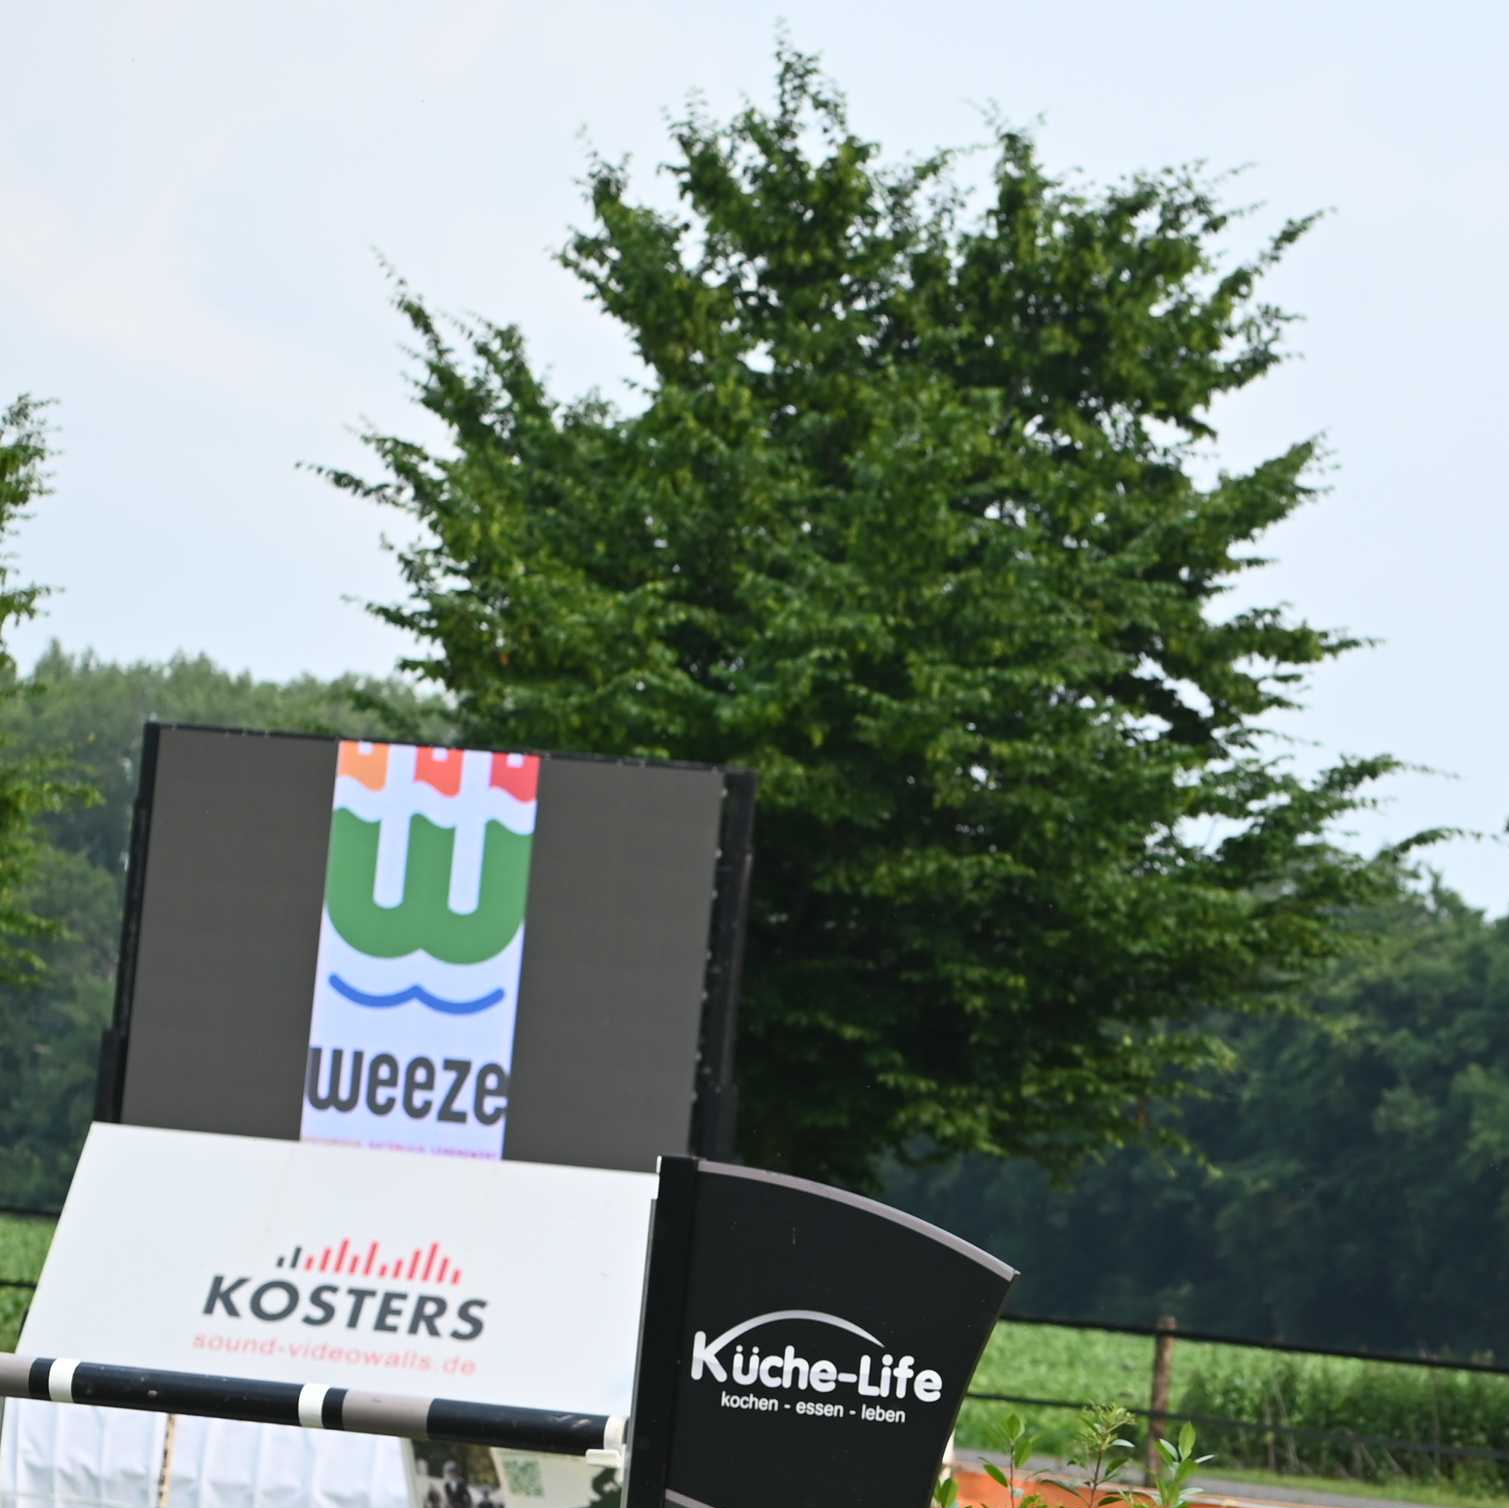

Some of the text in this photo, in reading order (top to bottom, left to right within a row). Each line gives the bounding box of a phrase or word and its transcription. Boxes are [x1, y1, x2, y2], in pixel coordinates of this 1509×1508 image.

[306, 1047, 510, 1126] weeze
[192, 1332, 477, 1376] sound-videowalls.de
[691, 1330, 943, 1403] Küche-Life
[720, 1391, 779, 1412] kochen
[795, 1400, 844, 1418] essen
[861, 1403, 906, 1423] leben
